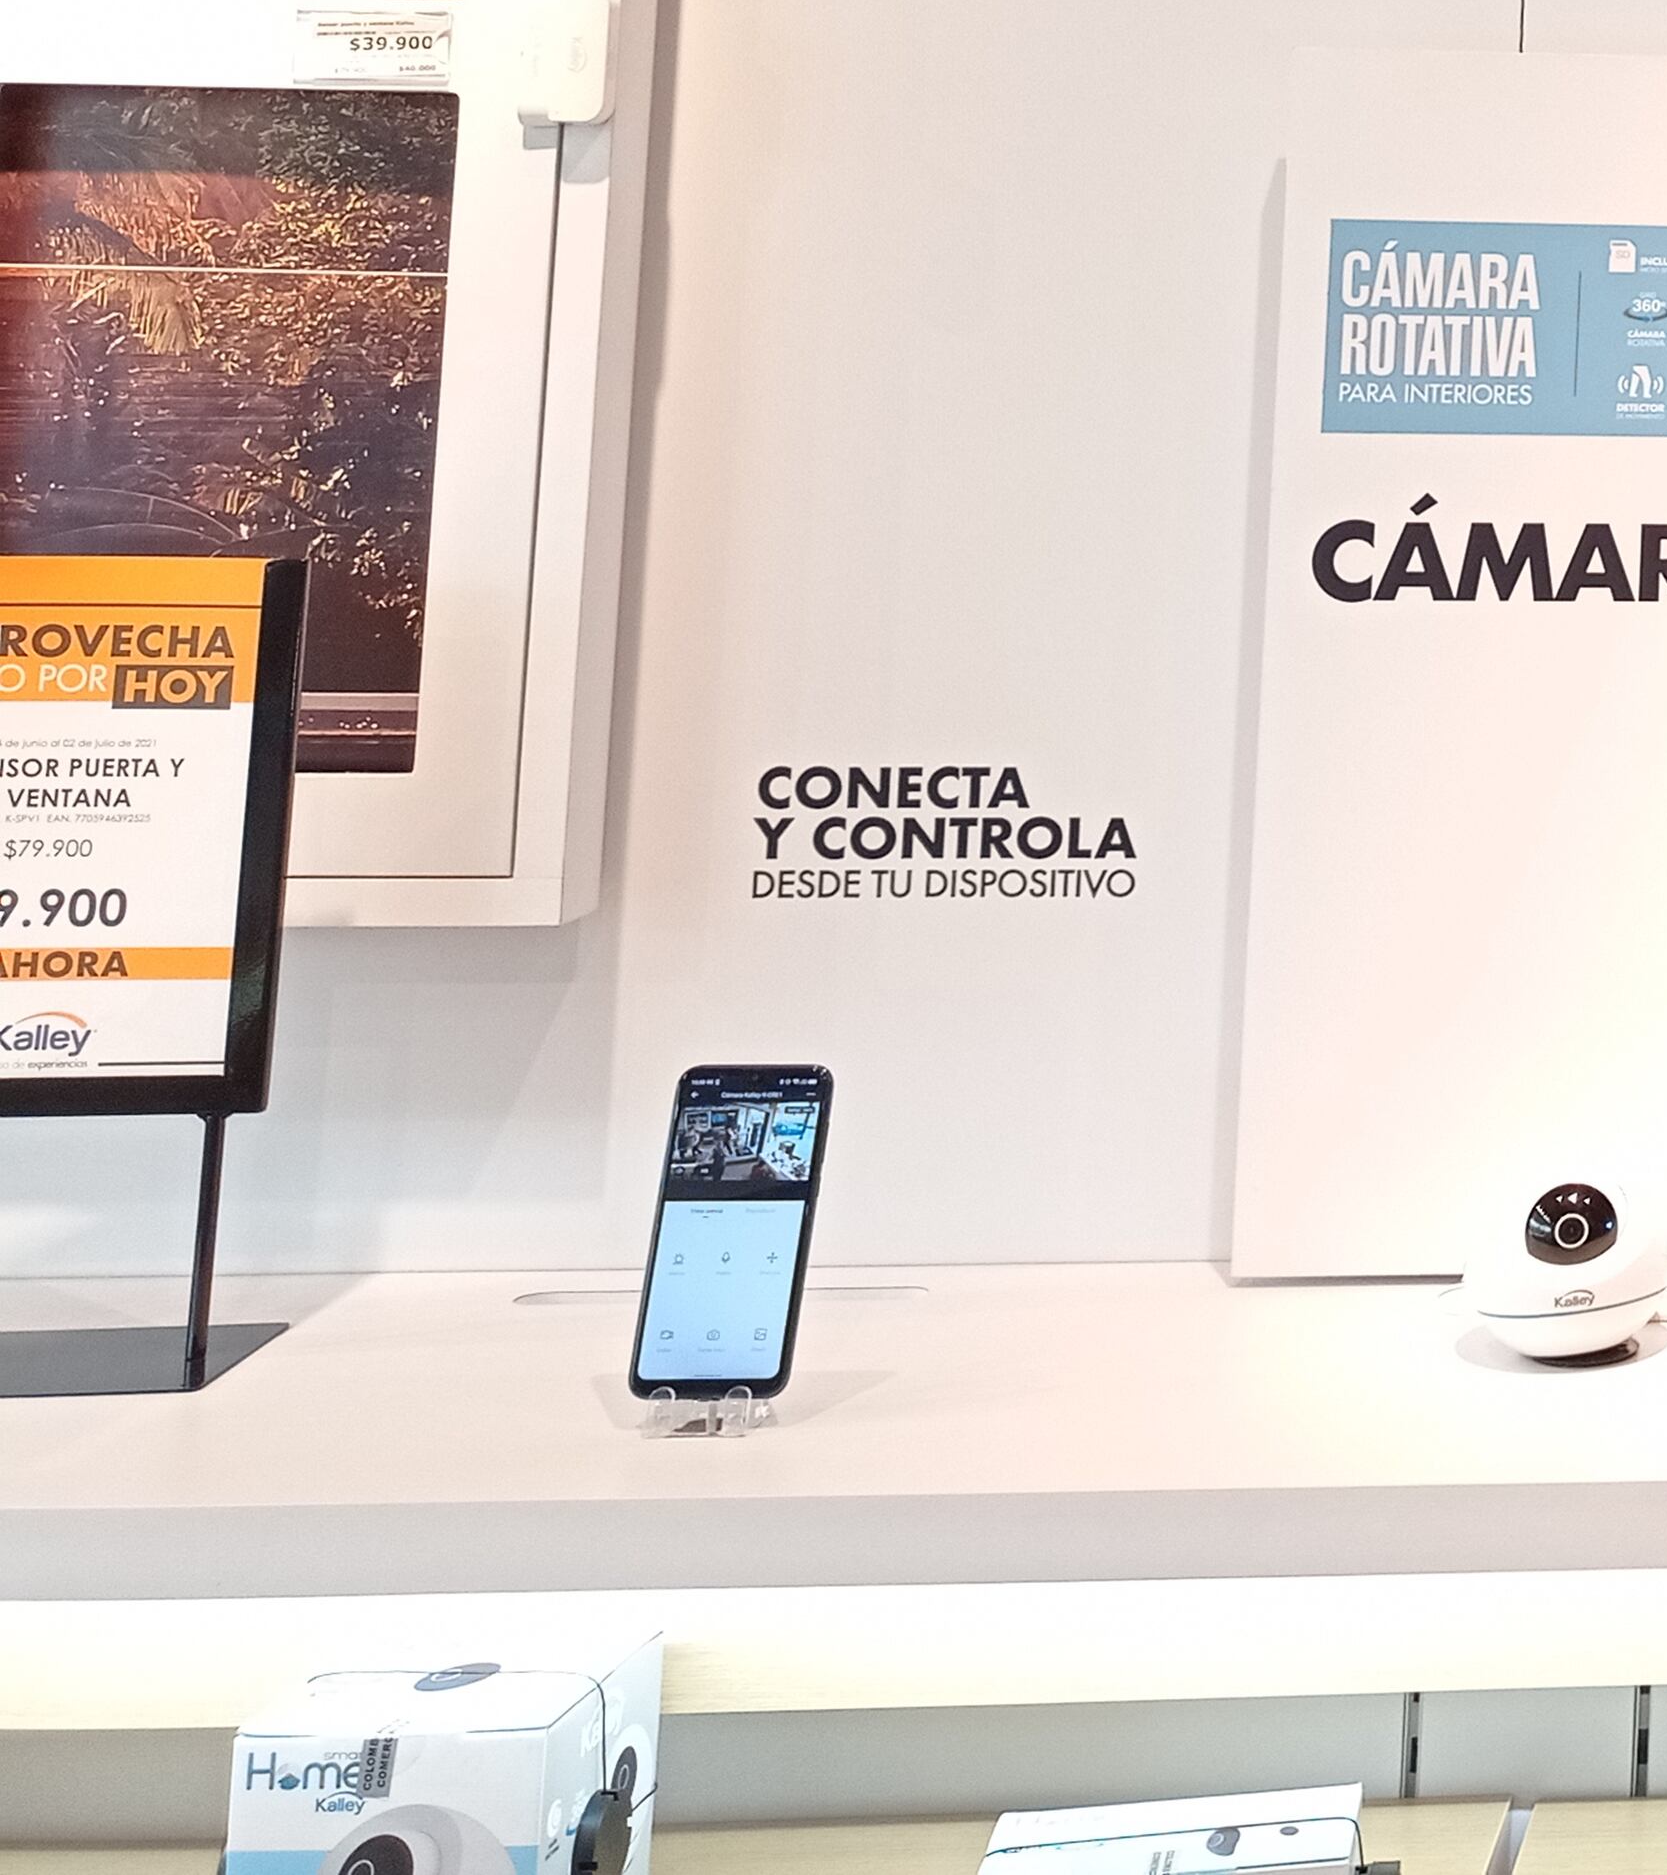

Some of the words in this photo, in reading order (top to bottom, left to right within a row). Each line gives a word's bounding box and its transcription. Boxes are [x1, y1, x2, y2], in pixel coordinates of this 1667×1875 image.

[349, 36, 433, 51] $39.900
[1340, 239, 1541, 310] CÁMARA
[1339, 313, 1537, 378] ROTATIVA
[1338, 382, 1397, 404] PARA
[1403, 383, 1533, 406] INTERIORES
[1616, 403, 1665, 413] DETECTOR
[38, 663, 107, 692] POR
[123, 668, 228, 704] HOY
[69, 758, 160, 778] PUERTA
[170, 757, 185, 777] Y
[757, 765, 1030, 809] CONECTA
[7, 788, 131, 809] VENTANA
[3, 839, 93, 859] $79.900
[753, 816, 795, 860] Y
[812, 815, 1138, 861] CONTROLA
[751, 869, 861, 899] DESDE
[871, 869, 913, 899] TU
[924, 868, 1137, 900] DISPOSITIVO
[1554, 1291, 1596, 1309] Kalley
[314, 1795, 366, 1816] Kalley
